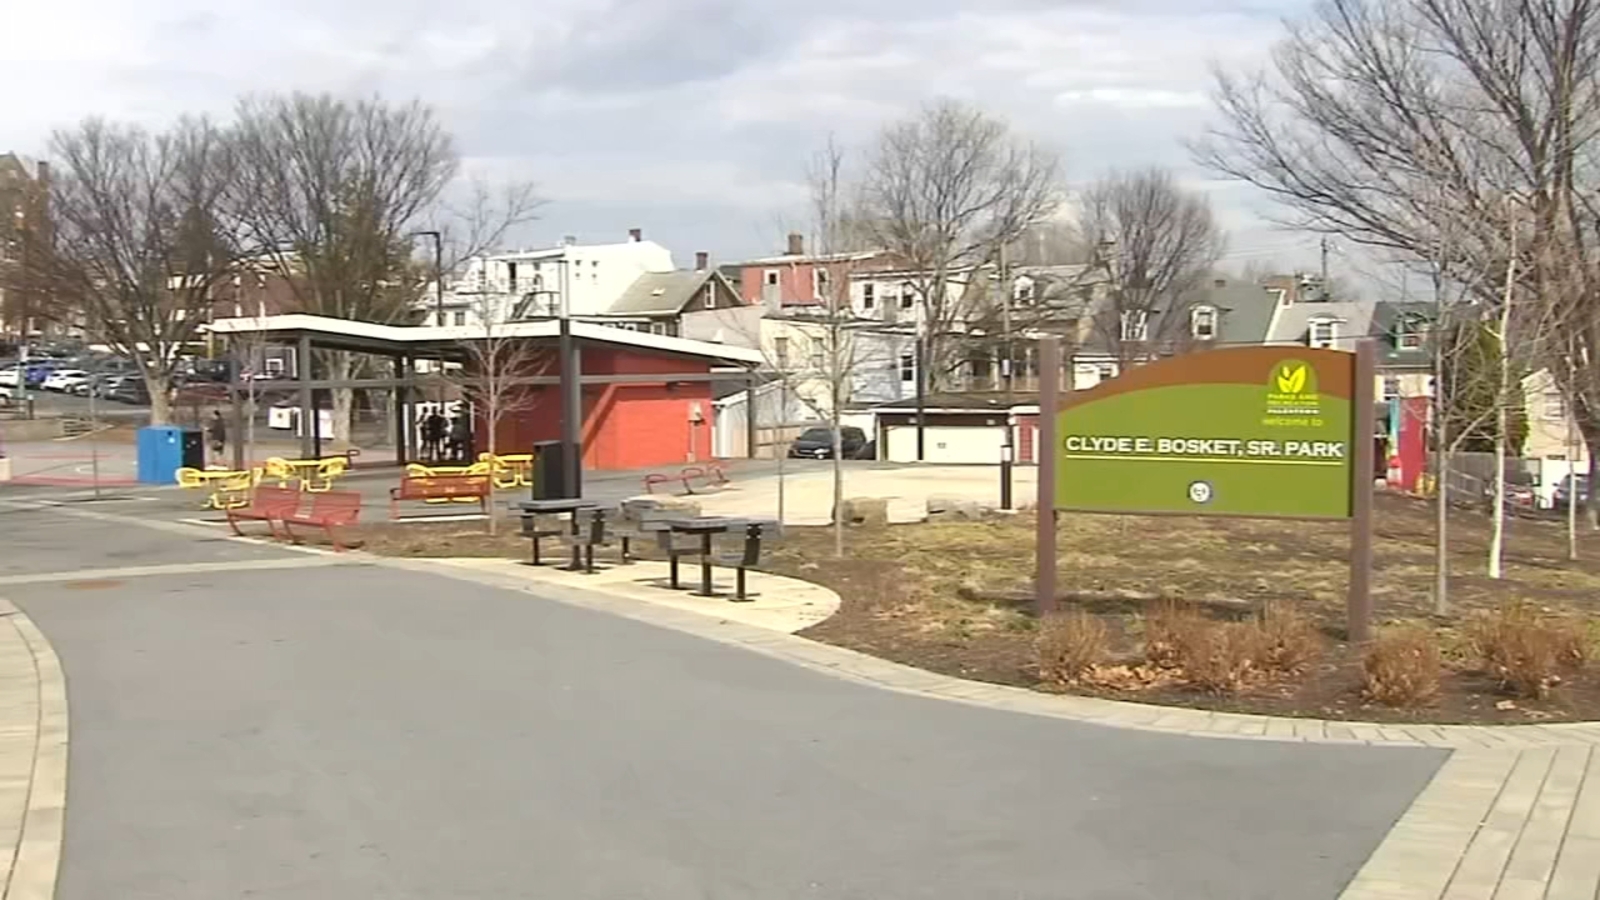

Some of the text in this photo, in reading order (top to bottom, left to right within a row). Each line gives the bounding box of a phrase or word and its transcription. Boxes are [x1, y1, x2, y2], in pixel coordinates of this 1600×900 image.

[1262, 417, 1324, 427] welcome to
[1066, 436, 1345, 457] CLYDE E. BOSKET, SR. PARK
